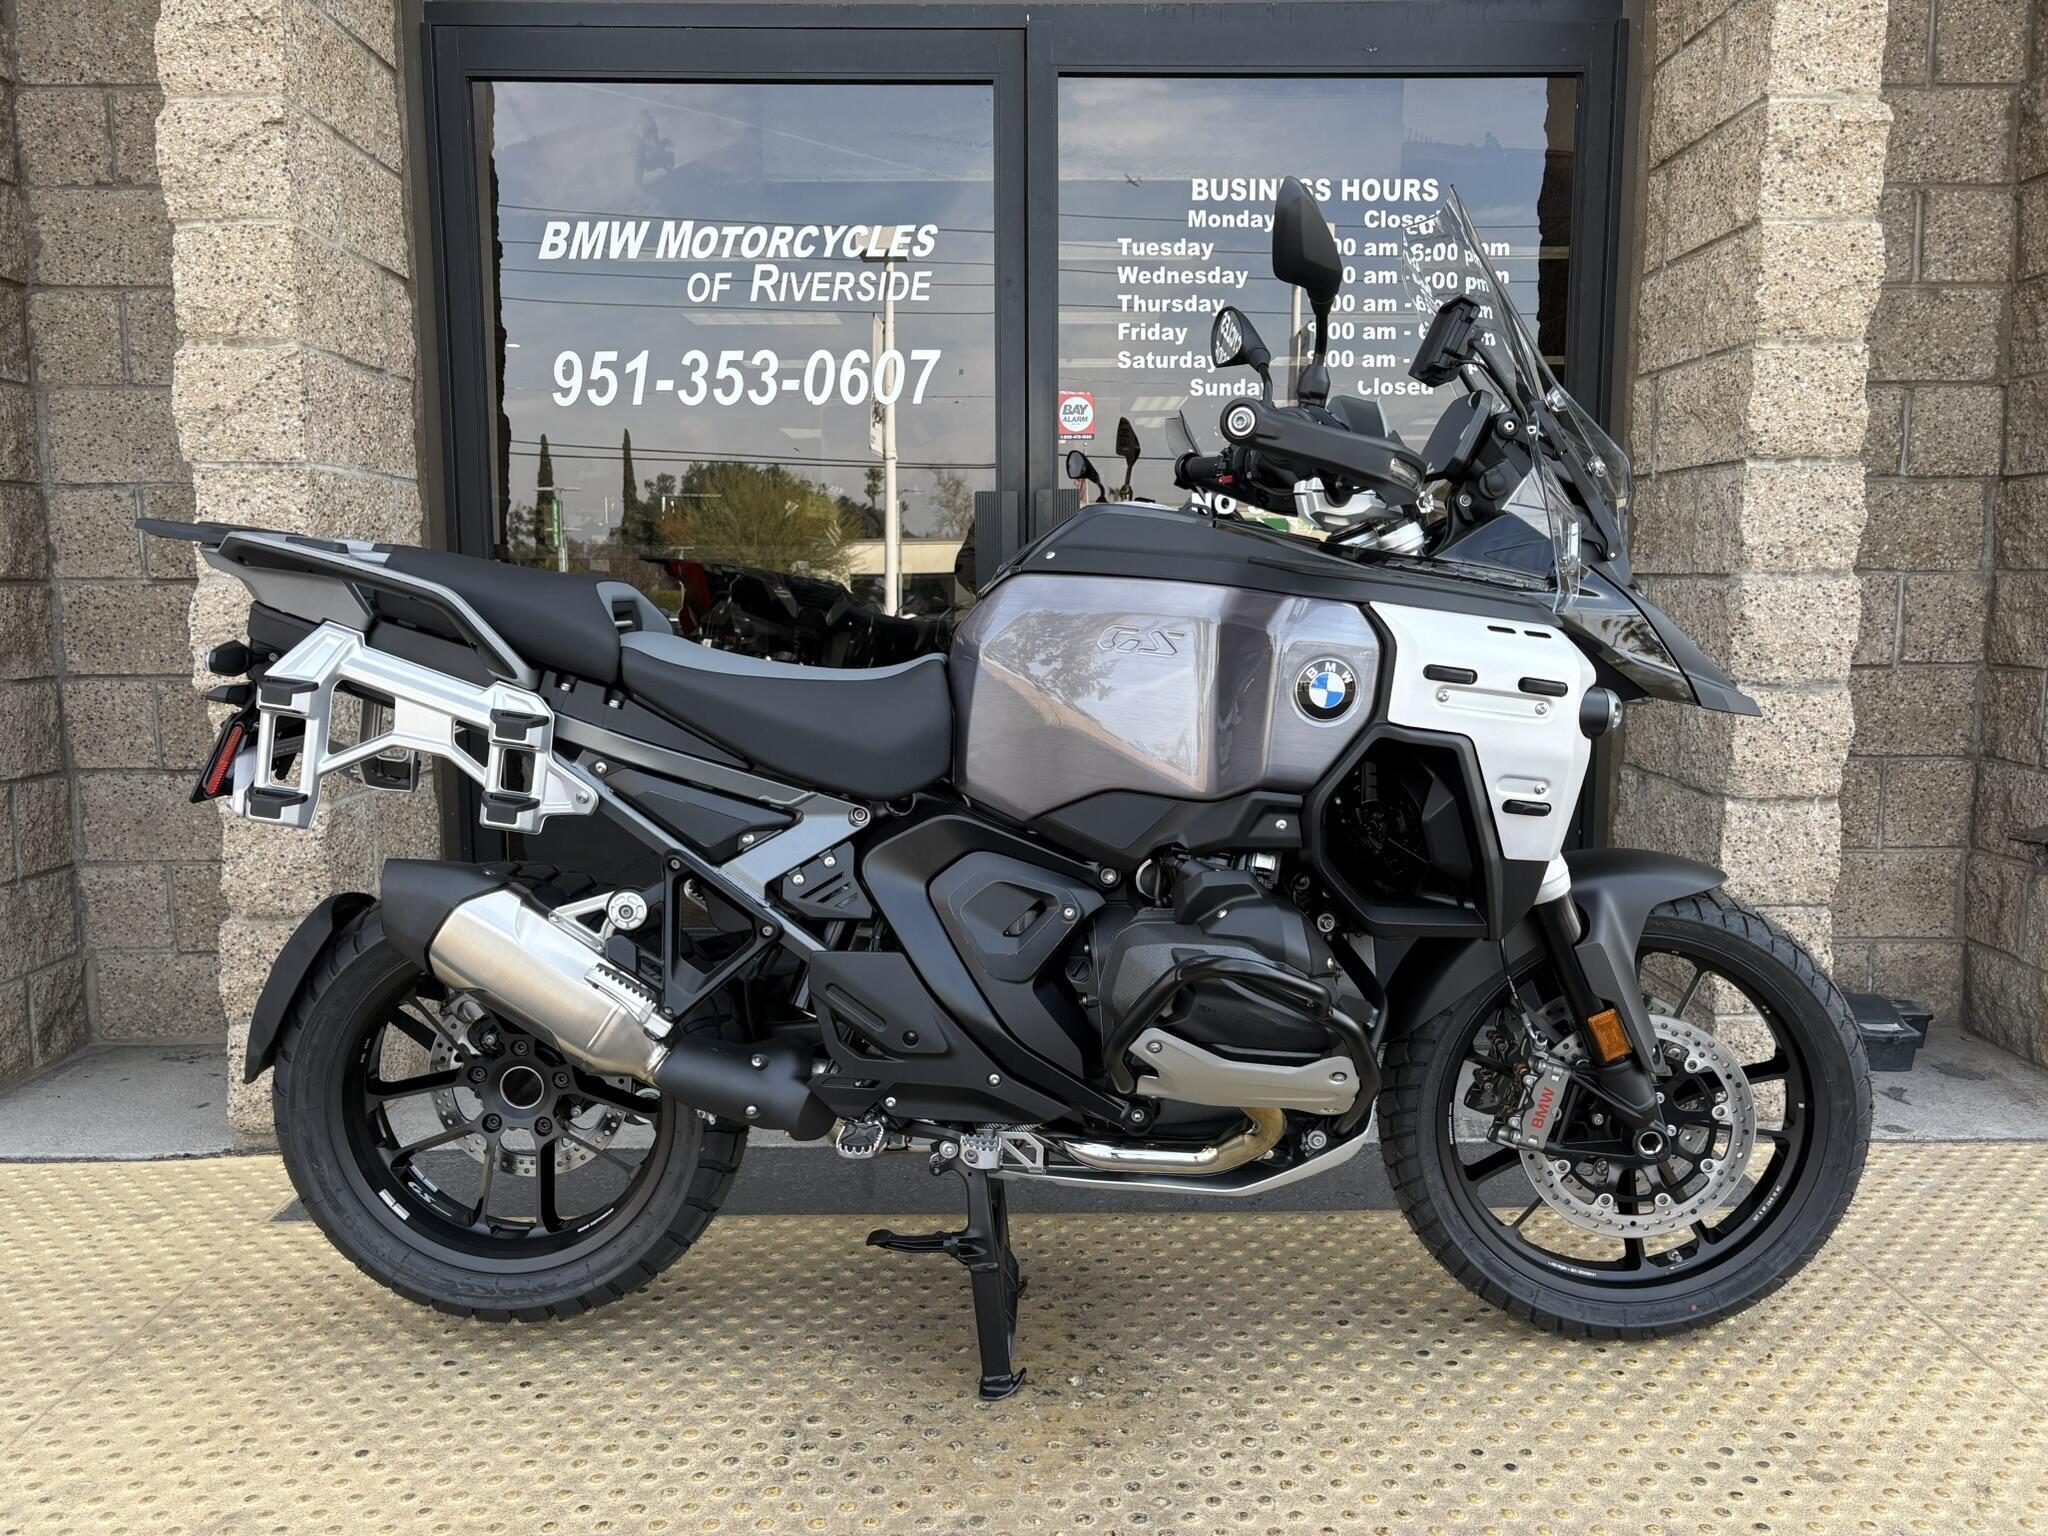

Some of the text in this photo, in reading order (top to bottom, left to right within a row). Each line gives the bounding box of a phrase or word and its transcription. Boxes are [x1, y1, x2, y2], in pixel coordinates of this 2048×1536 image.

[1191, 177, 1439, 202] BUSINS HOURS
[1188, 209, 1275, 233] Monday
[538, 220, 939, 260] BMW MOTORCYCLES
[1117, 237, 1215, 260] Tuesday
[1363, 242, 1398, 256] am
[687, 263, 933, 303] OF RIVERSIDE
[1117, 266, 1249, 289] Wednesday
[1363, 270, 1398, 284] am
[1117, 294, 1225, 317] Thursday
[1362, 298, 1397, 312] am
[1117, 322, 1188, 346] Friday
[1362, 326, 1397, 340] am
[1117, 350, 1216, 374] Saturday
[1361, 354, 1396, 368] am
[552, 348, 942, 407] 951-353-0607
[1189, 378, 1264, 397] Sunda
[1062, 404, 1089, 416] BAY
[1306, 661, 1354, 684] BMW
[1530, 1086, 1555, 1130] BMW
